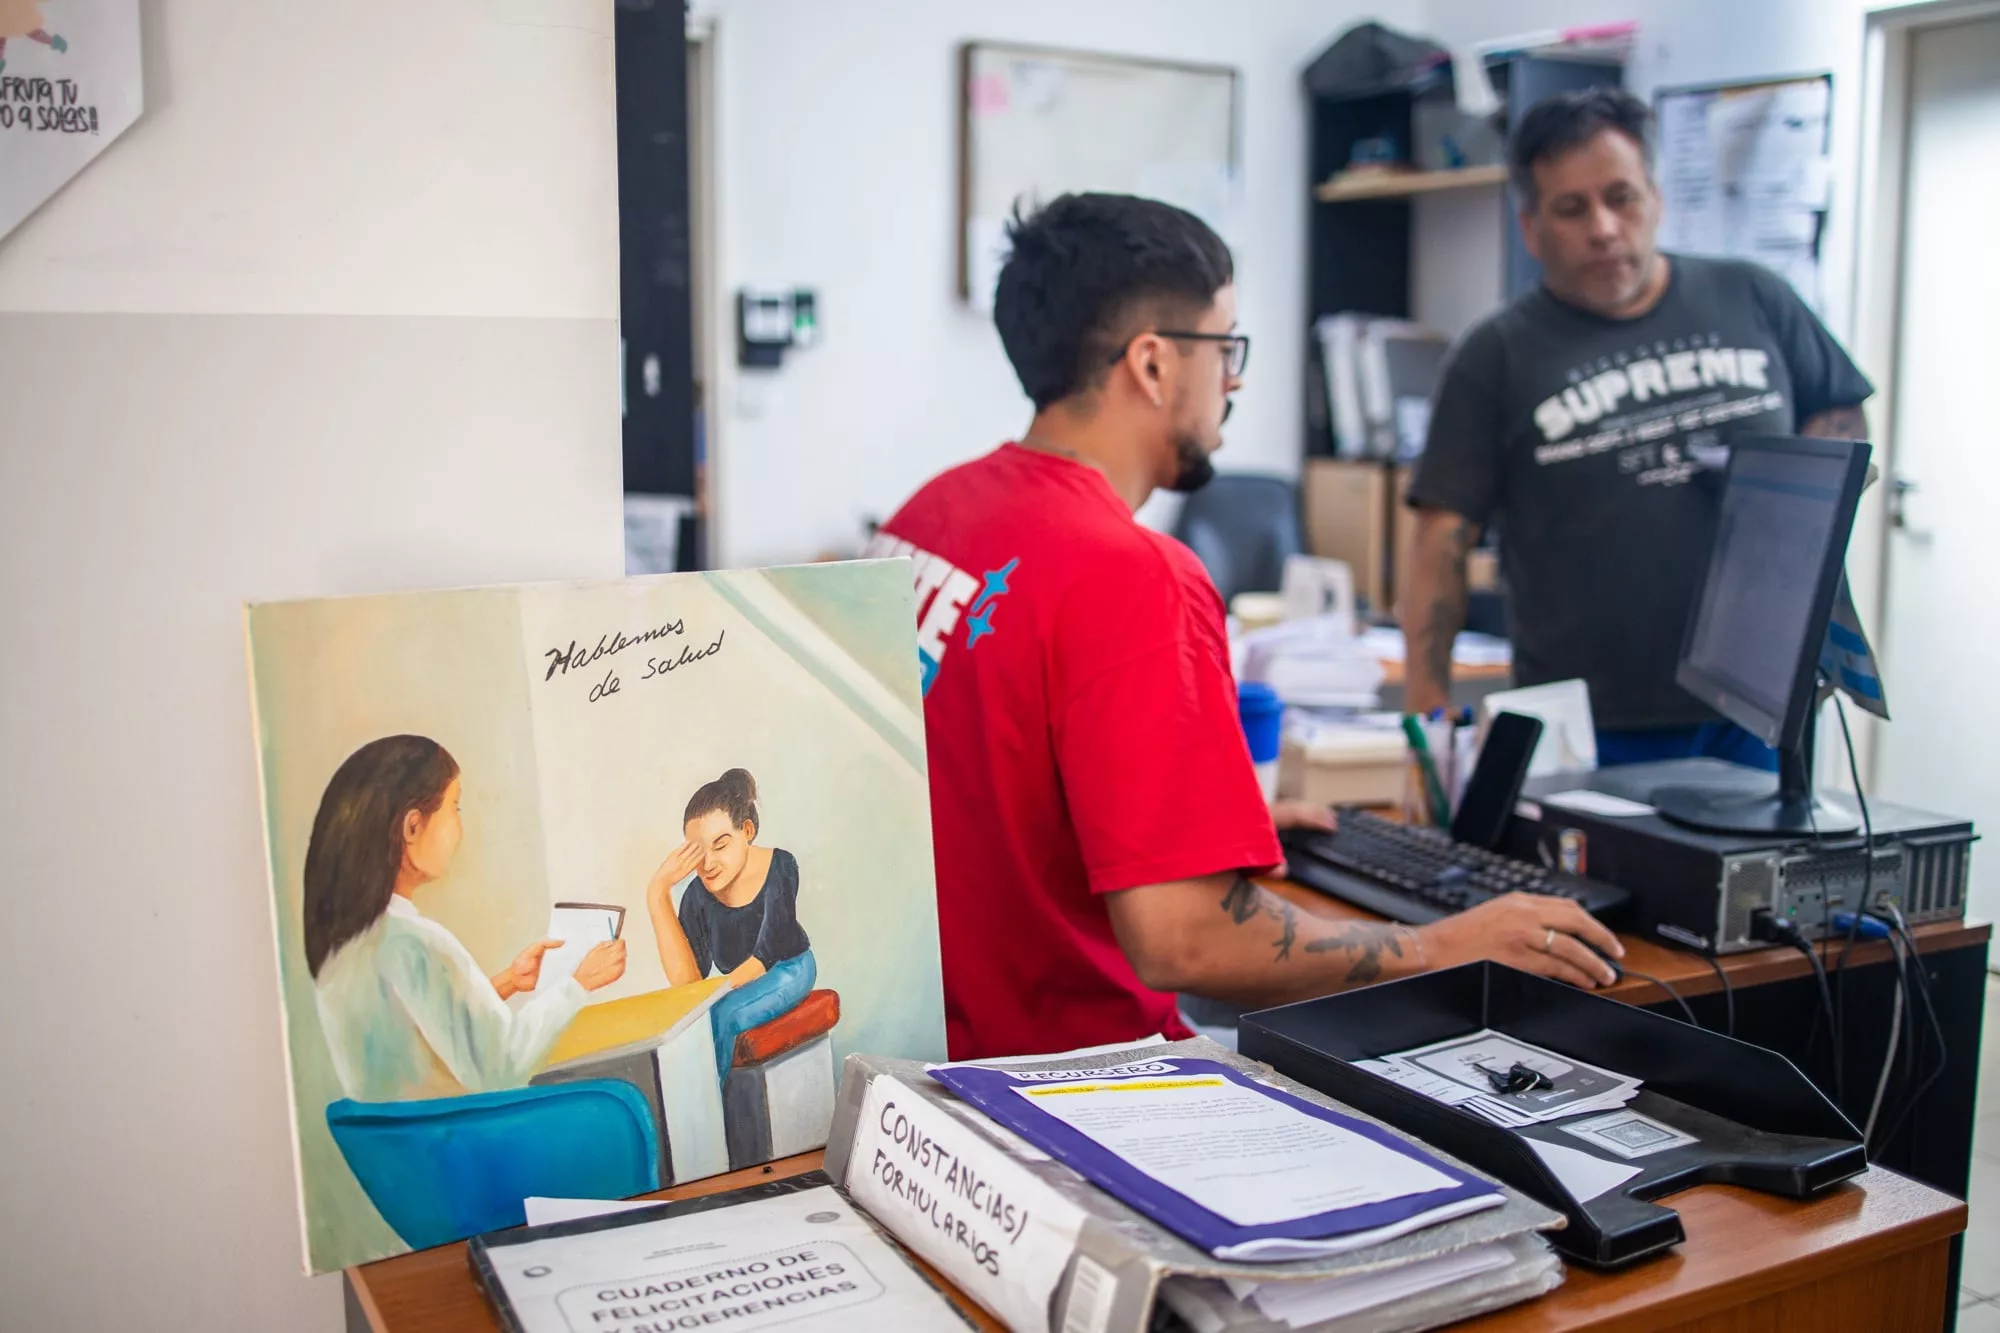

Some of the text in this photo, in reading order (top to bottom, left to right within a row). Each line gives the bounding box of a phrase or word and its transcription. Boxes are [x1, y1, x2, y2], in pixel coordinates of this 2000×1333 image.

[0, 104, 14, 129] O
[55, 79, 78, 105] TU
[1533, 347, 1769, 441] SUPREME
[545, 618, 684, 682] Hablemos
[589, 669, 621, 703] de
[1019, 1064, 1165, 1081] RECURSERO
[591, 1262, 846, 1322] FELICITACIONES
[597, 1250, 819, 1302] CUADERNO DE
[633, 1280, 857, 1333] SUGERENCIAS
